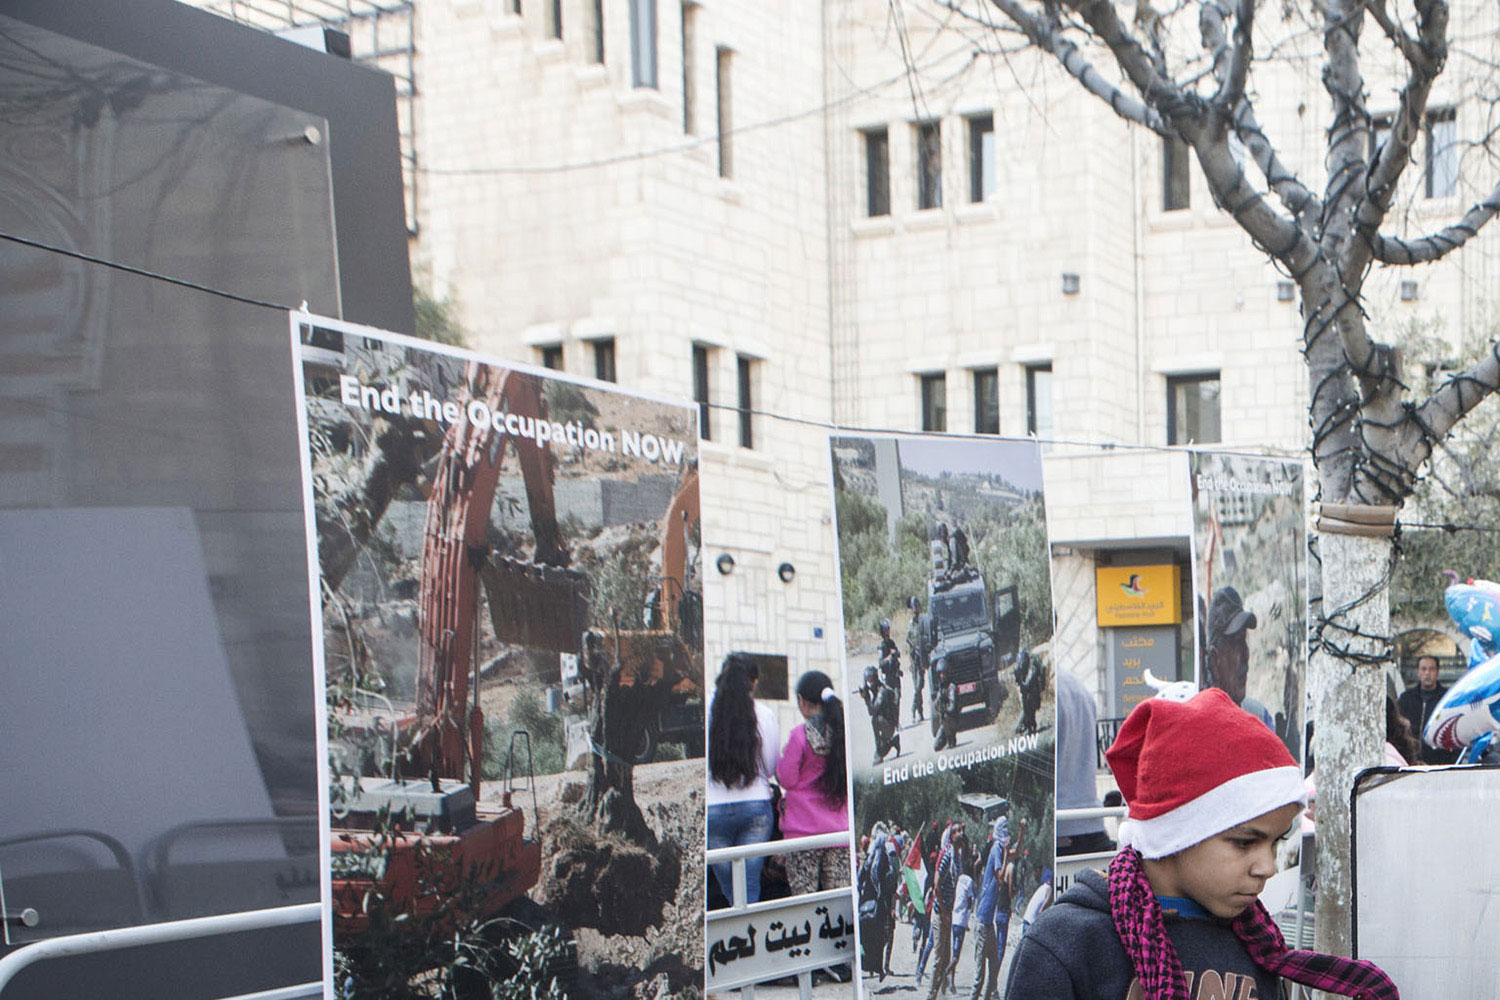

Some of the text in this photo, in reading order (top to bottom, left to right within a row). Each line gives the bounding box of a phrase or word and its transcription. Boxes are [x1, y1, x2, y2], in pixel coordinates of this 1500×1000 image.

[339, 374, 686, 464] End the Occupation NOW
[883, 733, 1039, 785] End the Occupation NOW
[709, 923, 757, 978] لحم
[765, 919, 811, 958] بيت
